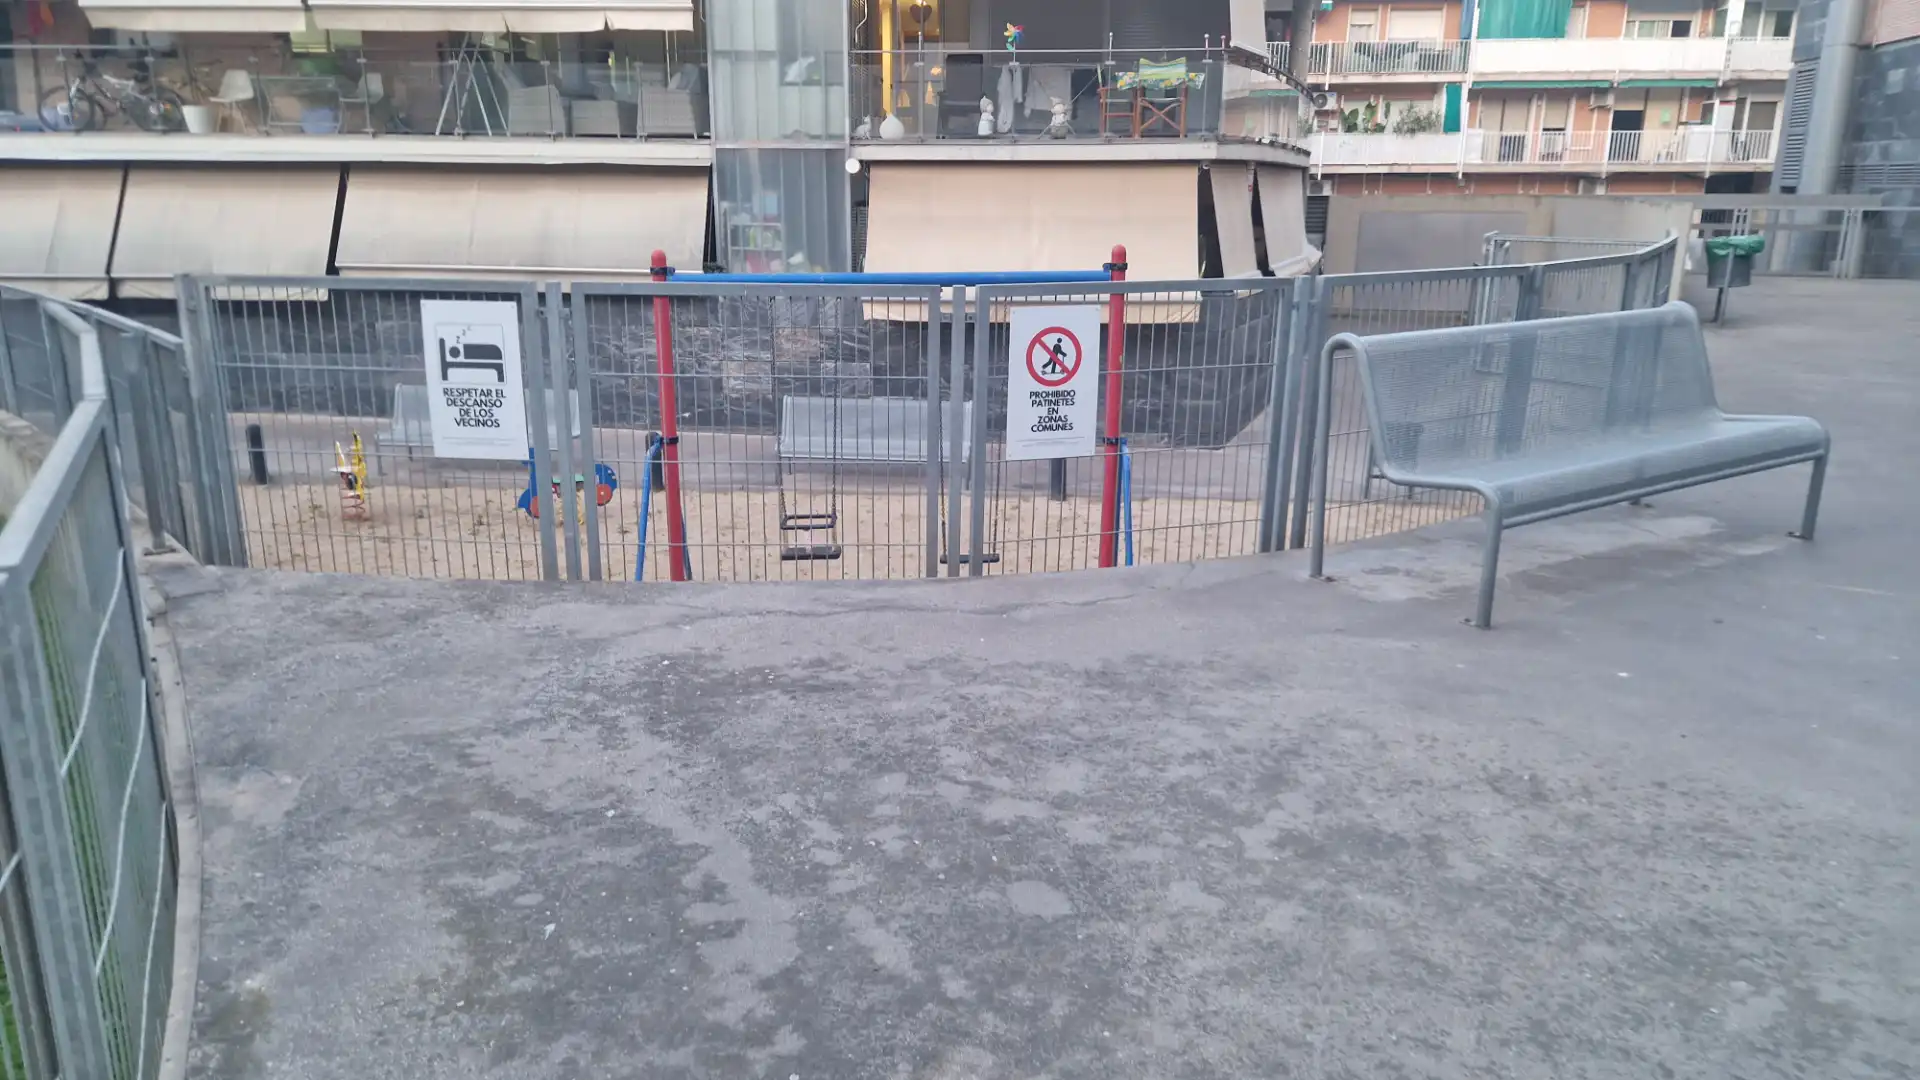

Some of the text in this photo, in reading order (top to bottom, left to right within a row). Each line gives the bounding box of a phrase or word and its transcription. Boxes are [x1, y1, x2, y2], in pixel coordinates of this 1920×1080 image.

[443, 387, 507, 398] RESPETAR EL
[1029, 389, 1076, 399] PROHIBIDO
[446, 397, 503, 408] DESCANSO
[1031, 398, 1075, 407] PATINETES
[459, 407, 494, 417] DE LOS
[1047, 407, 1059, 415] EN
[454, 417, 500, 428] VECINOS
[1037, 415, 1068, 424] ZONAS
[1031, 422, 1074, 433] COMUNES
